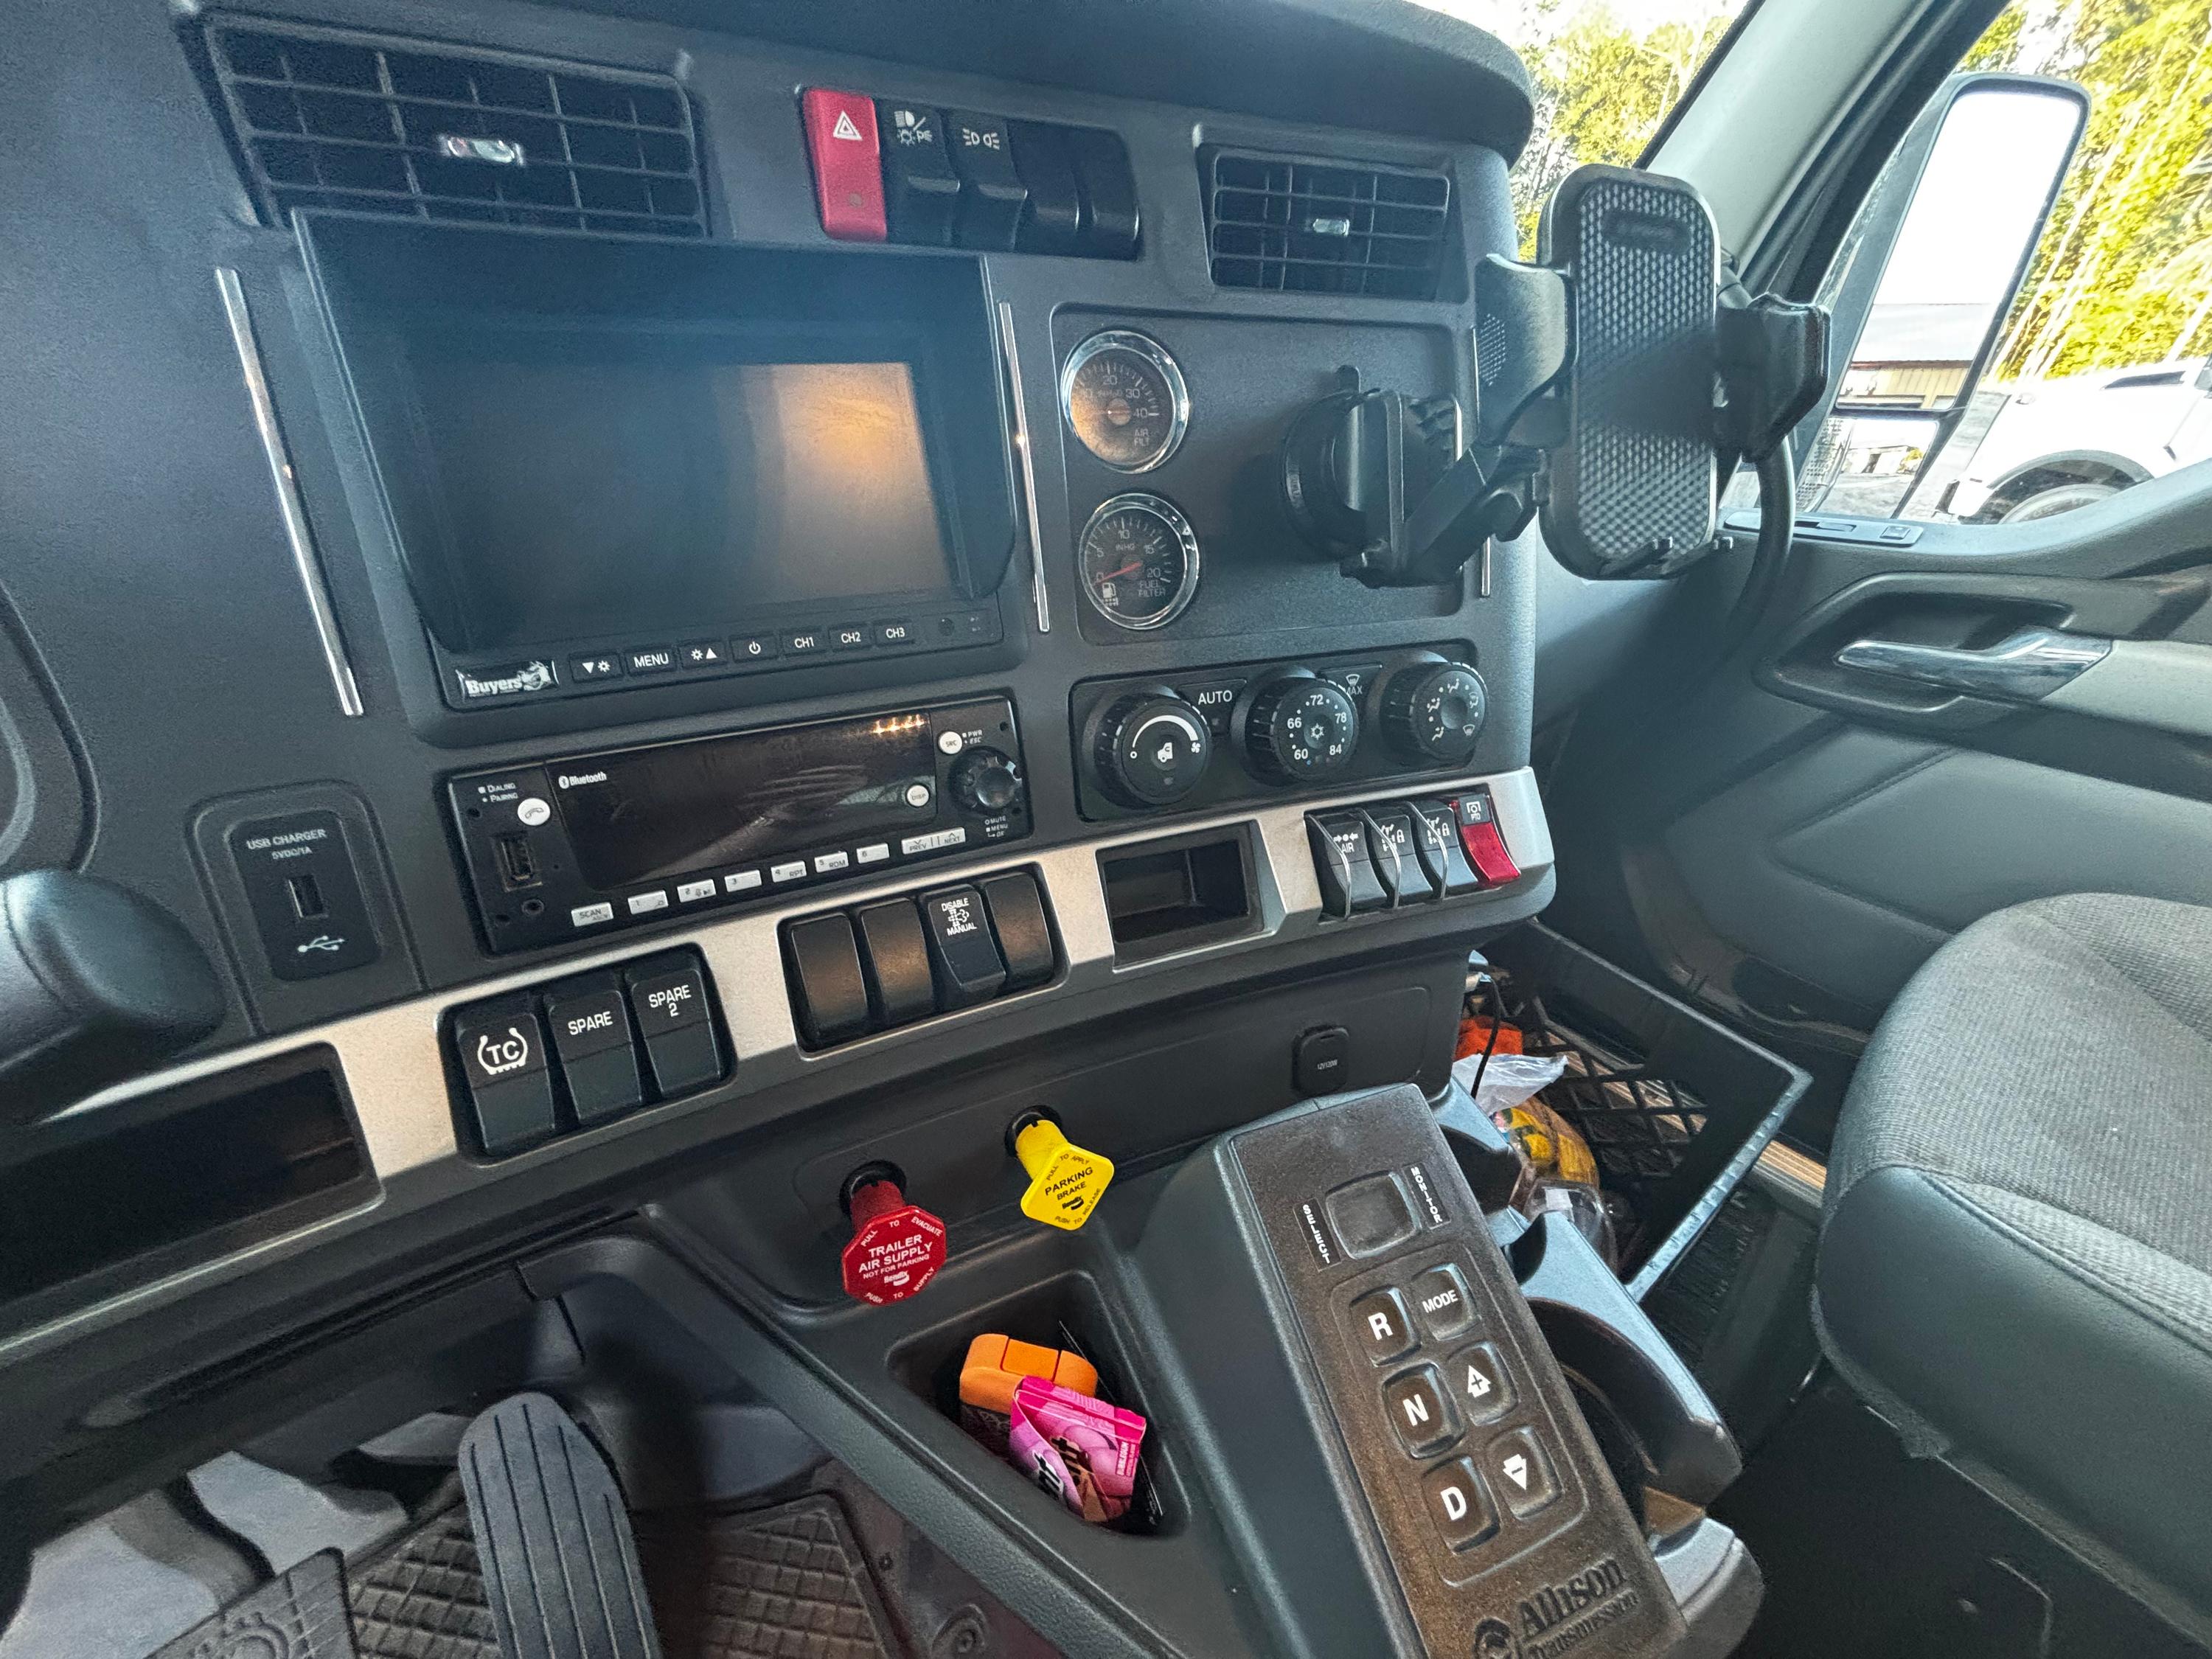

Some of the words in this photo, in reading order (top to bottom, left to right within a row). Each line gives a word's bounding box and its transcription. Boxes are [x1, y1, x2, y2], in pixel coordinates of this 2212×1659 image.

[1103, 375, 1117, 385] 20
[1125, 389, 1140, 398] 30
[1133, 408, 1148, 417] 40
[1118, 529, 1130, 539] 10
[1096, 548, 1104, 557] 5
[1144, 545, 1155, 554] 15
[1147, 568, 1161, 578] 20
[1139, 580, 1160, 588] FUEL
[1138, 589, 1166, 597] FILTER
[841, 632, 861, 644] CH2
[886, 627, 905, 639] CH3
[794, 636, 815, 649] CH1
[633, 653, 669, 668] MENU
[465, 678, 523, 695] Buyers
[1346, 685, 1363, 695] MAX
[1197, 690, 1233, 705] AUTO
[1310, 695, 1324, 706] 72
[1287, 717, 1302, 728] 66
[1335, 712, 1347, 723] 78
[1293, 748, 1309, 760] 60
[1329, 744, 1342, 755] 84
[568, 771, 607, 787] Bluetooth
[991, 824, 1008, 832] MENU
[246, 838, 271, 849] USB
[272, 829, 327, 845] CHARGER
[944, 837, 960, 845] NEXT
[909, 843, 927, 852] PREV
[1341, 842, 1354, 853] AIR
[789, 869, 804, 878] RPT
[941, 897, 970, 912] DISABLE
[580, 908, 602, 919] SCAN
[947, 922, 977, 936] MANUAL
[648, 984, 692, 1009] SPARE
[669, 1002, 679, 1018] 2
[567, 1010, 613, 1036] SPARE
[486, 1040, 521, 1065] TC
[1060, 1153, 1069, 1161] TO
[1045, 1167, 1093, 1196] PARKING
[1057, 1181, 1086, 1200] BRAKE
[1411, 1166, 1443, 1223] MONITOR
[860, 1230, 878, 1247] PULL
[889, 1220, 900, 1228] TO
[911, 1217, 942, 1237] EVACUATE
[1302, 1204, 1330, 1264] SELECT
[869, 1234, 922, 1257] TRAILER
[859, 1259, 880, 1273] AIR
[884, 1242, 933, 1265] SUPPLY
[863, 1270, 879, 1279] NOT
[880, 1265, 896, 1274] FOR
[897, 1253, 930, 1268] PARKING
[866, 1292, 883, 1304] PUSH
[914, 1267, 935, 1292] SUPPLY
[1422, 1290, 1458, 1313] MODE
[1368, 1312, 1393, 1340] R
[1402, 1394, 1429, 1427] N
[1440, 1486, 1467, 1520] D
